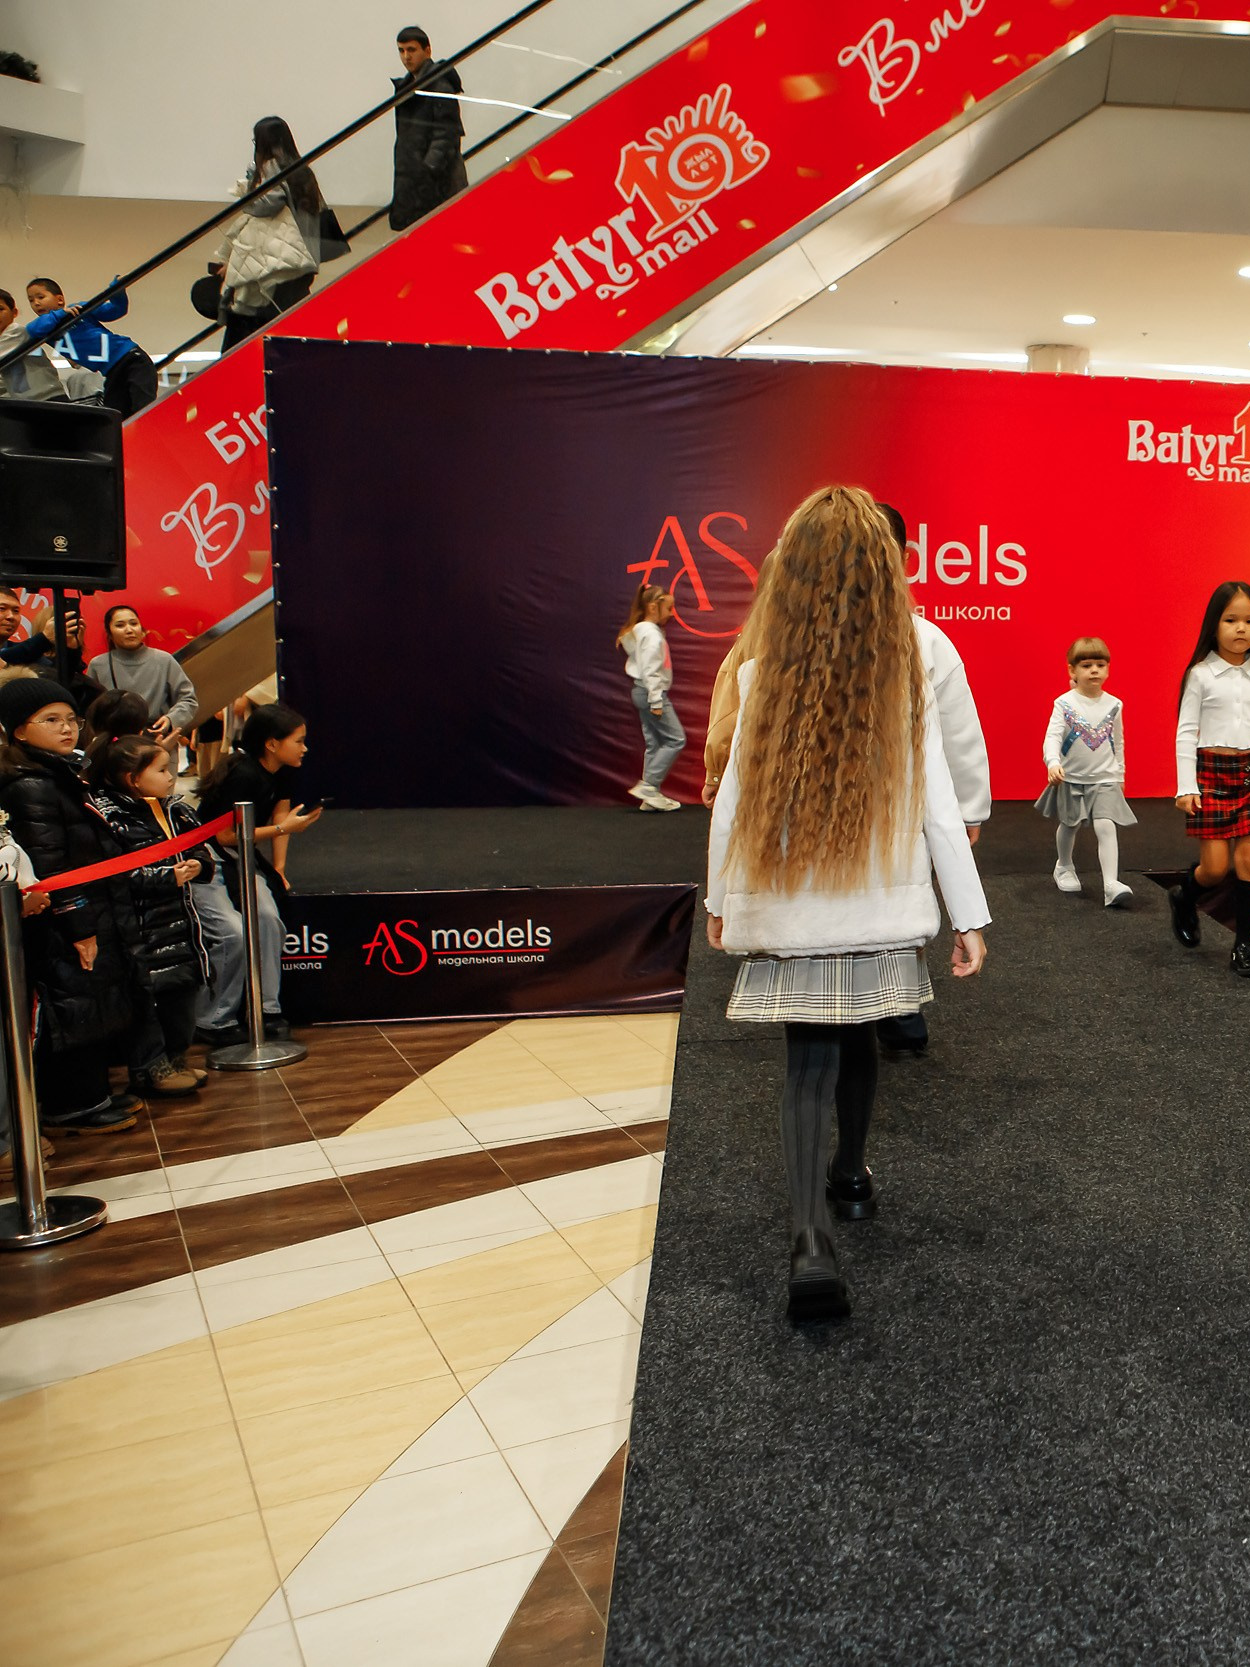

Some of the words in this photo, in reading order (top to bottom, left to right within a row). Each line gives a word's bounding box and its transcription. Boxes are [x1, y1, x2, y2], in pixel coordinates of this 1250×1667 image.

[636, 208, 719, 277] mall
[474, 206, 644, 341] Batyr
[1127, 419, 1235, 481] Batyr
[905, 523, 1028, 587] dels
[934, 605, 1011, 621] школа
[282, 925, 330, 954] els
[282, 962, 322, 971] школа
[362, 919, 428, 976] AS
[431, 918, 552, 950] models
[437, 956, 504, 967] модельная
[507, 954, 545, 964] школа
